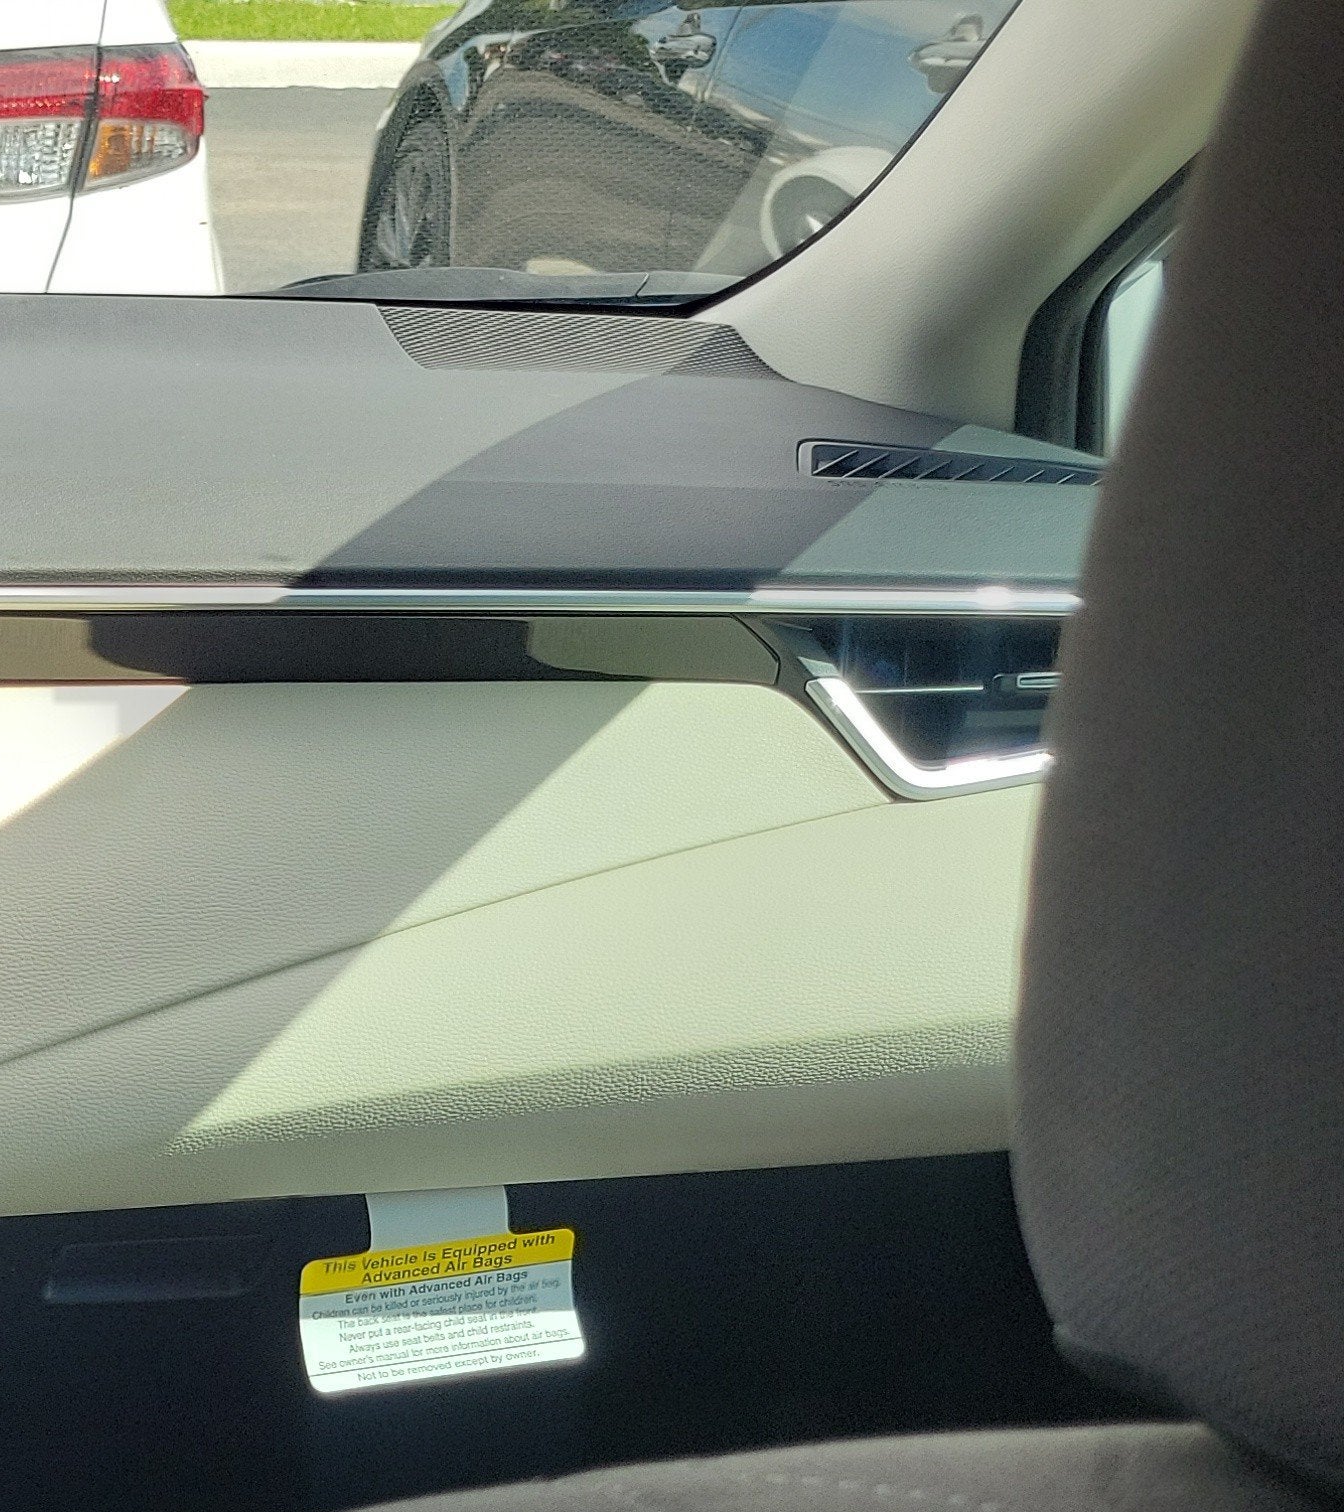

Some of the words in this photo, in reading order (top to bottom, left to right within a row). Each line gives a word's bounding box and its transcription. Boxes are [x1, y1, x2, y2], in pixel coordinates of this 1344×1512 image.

[324, 1260, 356, 1274] This
[363, 1254, 417, 1270] Vehicle
[442, 1239, 517, 1262] Equipped
[522, 1234, 555, 1247] with
[362, 1263, 440, 1284] Advanced
[444, 1261, 467, 1272] Air
[473, 1254, 512, 1268] Bags
[312, 1307, 350, 1320] Children
[352, 1306, 368, 1315] can
[371, 1303, 382, 1313] be
[385, 1299, 408, 1310] killed
[422, 1294, 463, 1307] seriously
[465, 1288, 495, 1300] injured
[498, 1286, 508, 1296] by
[511, 1283, 525, 1292] the
[527, 1280, 539, 1288] air
[345, 1293, 376, 1304] Even
[380, 1288, 406, 1299] with
[409, 1277, 471, 1295] Advanced
[475, 1275, 492, 1286] Air
[496, 1270, 528, 1283] Bags
[339, 1331, 366, 1342] Never
[368, 1328, 383, 1339] put
[385, 1327, 392, 1335] a
[394, 1319, 442, 1334] rear-facing
[444, 1314, 465, 1326] child
[467, 1312, 487, 1322] seat
[489, 1312, 497, 1320] in
[500, 1309, 513, 1318] the
[349, 1342, 380, 1354] Always
[383, 1340, 399, 1348] use
[402, 1337, 421, 1346] seat
[423, 1332, 445, 1343] belts
[448, 1328, 465, 1338] and
[467, 1324, 488, 1336] child
[319, 1360, 337, 1371] See
[339, 1355, 374, 1367] owner's
[376, 1348, 409, 1362] manual
[411, 1347, 423, 1356] for
[426, 1344, 450, 1354] more
[452, 1338, 501, 1351] information
[503, 1333, 530, 1344] about
[532, 1331, 543, 1340] air
[357, 1370, 376, 1382] Not
[379, 1368, 388, 1378] to
[391, 1366, 405, 1376] be
[407, 1360, 452, 1374] removed
[454, 1356, 489, 1369] except
[492, 1353, 503, 1364] by
